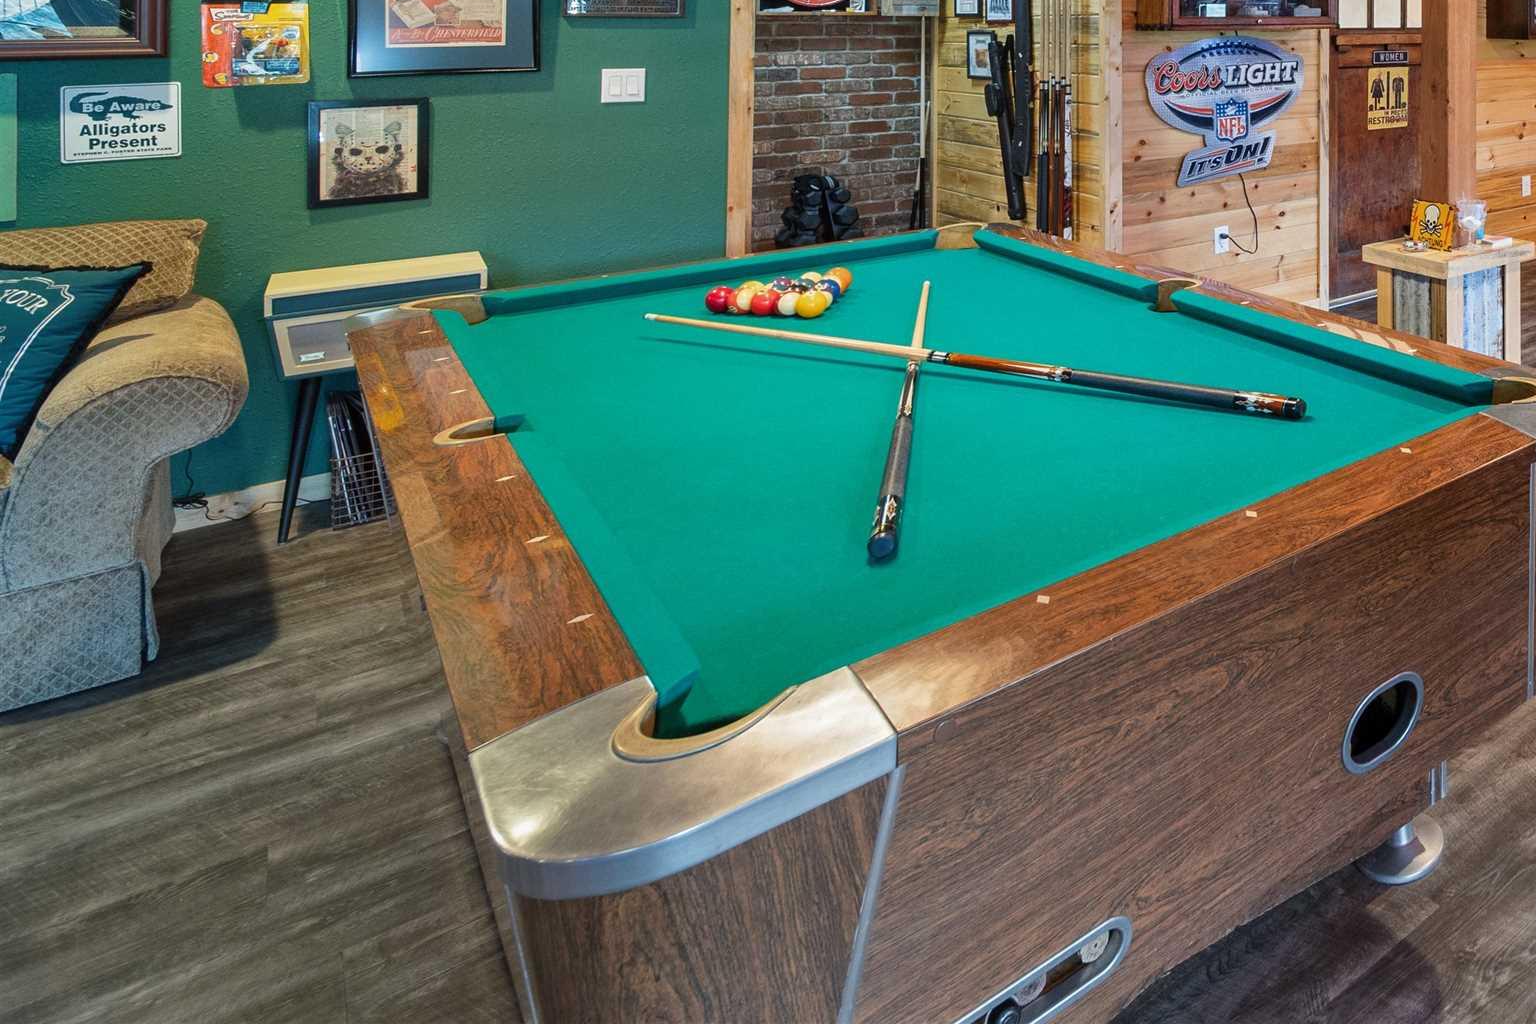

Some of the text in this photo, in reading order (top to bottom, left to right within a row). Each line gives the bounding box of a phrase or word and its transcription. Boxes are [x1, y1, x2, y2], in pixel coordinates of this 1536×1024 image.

[1379, 52, 1404, 62] WOMEN
[1152, 60, 1299, 95] Coors LIGHT
[82, 101, 161, 112] Be Aware
[80, 123, 166, 137] Alligators
[1218, 116, 1246, 138] NFL
[89, 136, 158, 150] Present
[1188, 136, 1272, 176] IT'S ON!
[0, 288, 48, 315] YOUR
